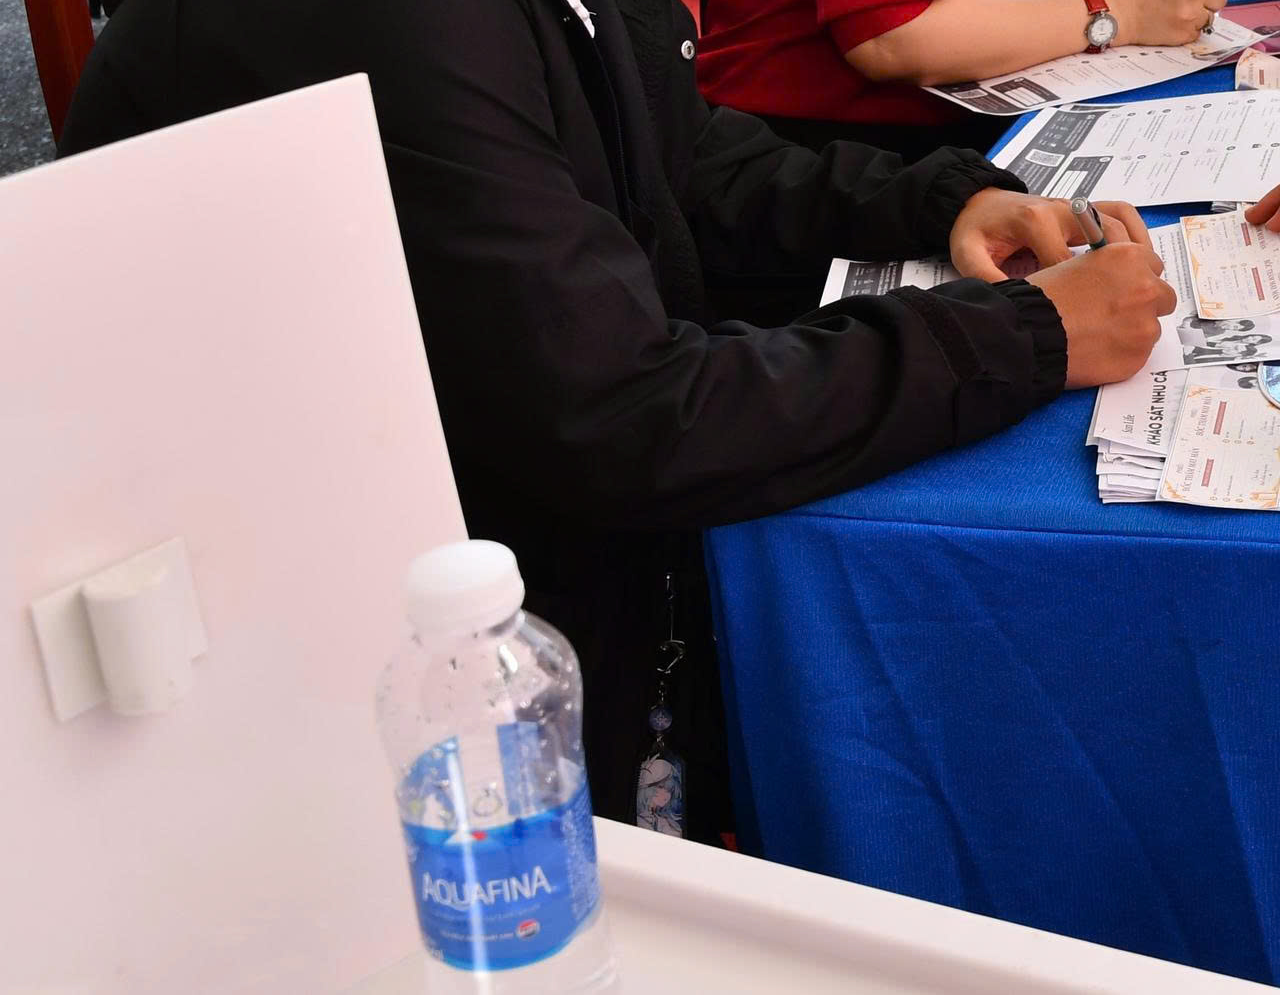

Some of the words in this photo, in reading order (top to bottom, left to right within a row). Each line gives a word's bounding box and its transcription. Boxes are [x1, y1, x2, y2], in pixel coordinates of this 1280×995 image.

[1152, 385, 1166, 403] NHU
[1147, 406, 1164, 421] SÁT
[1144, 421, 1162, 446] KHẢO
[422, 865, 553, 912] AQUAFINA
